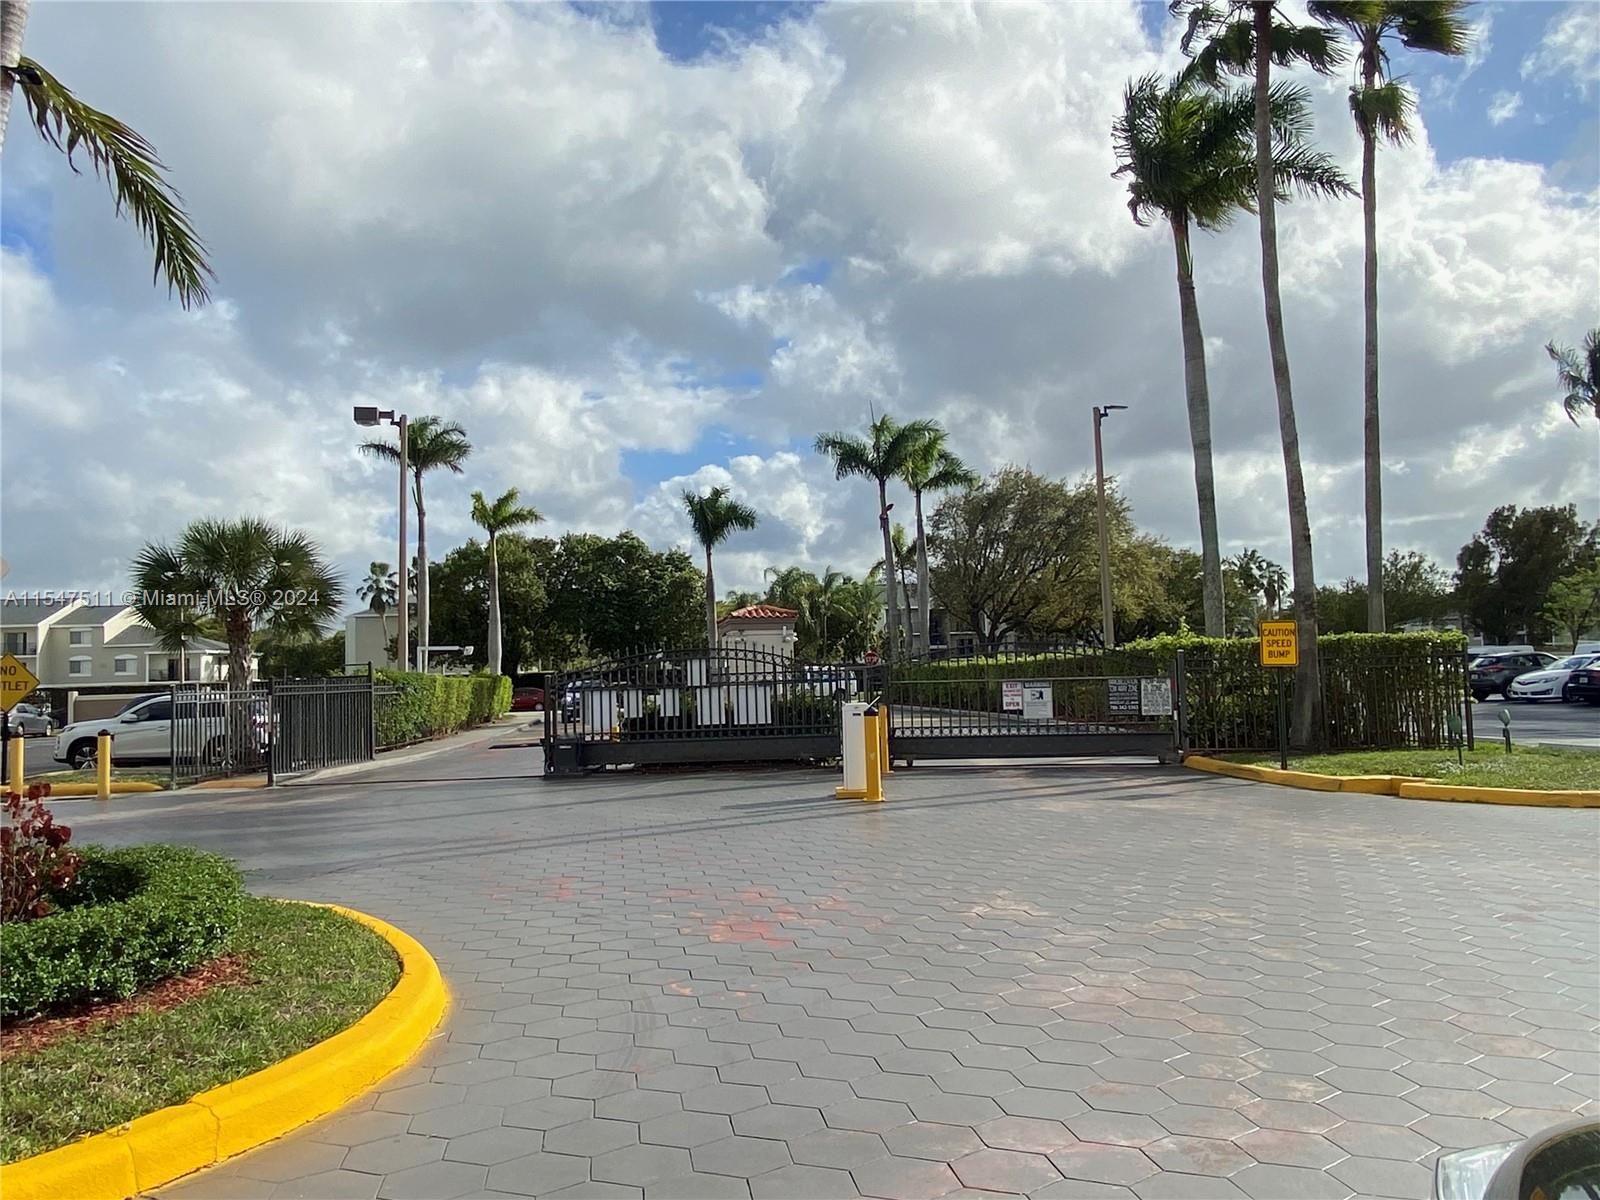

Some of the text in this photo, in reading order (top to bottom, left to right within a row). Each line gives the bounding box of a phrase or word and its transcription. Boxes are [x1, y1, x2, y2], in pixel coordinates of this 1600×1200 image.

[1263, 628, 1296, 637] CAUTION
[1266, 639, 1292, 648] SPEED
[1267, 650, 1290, 659] BUMP
[0, 665, 17, 676] NO
